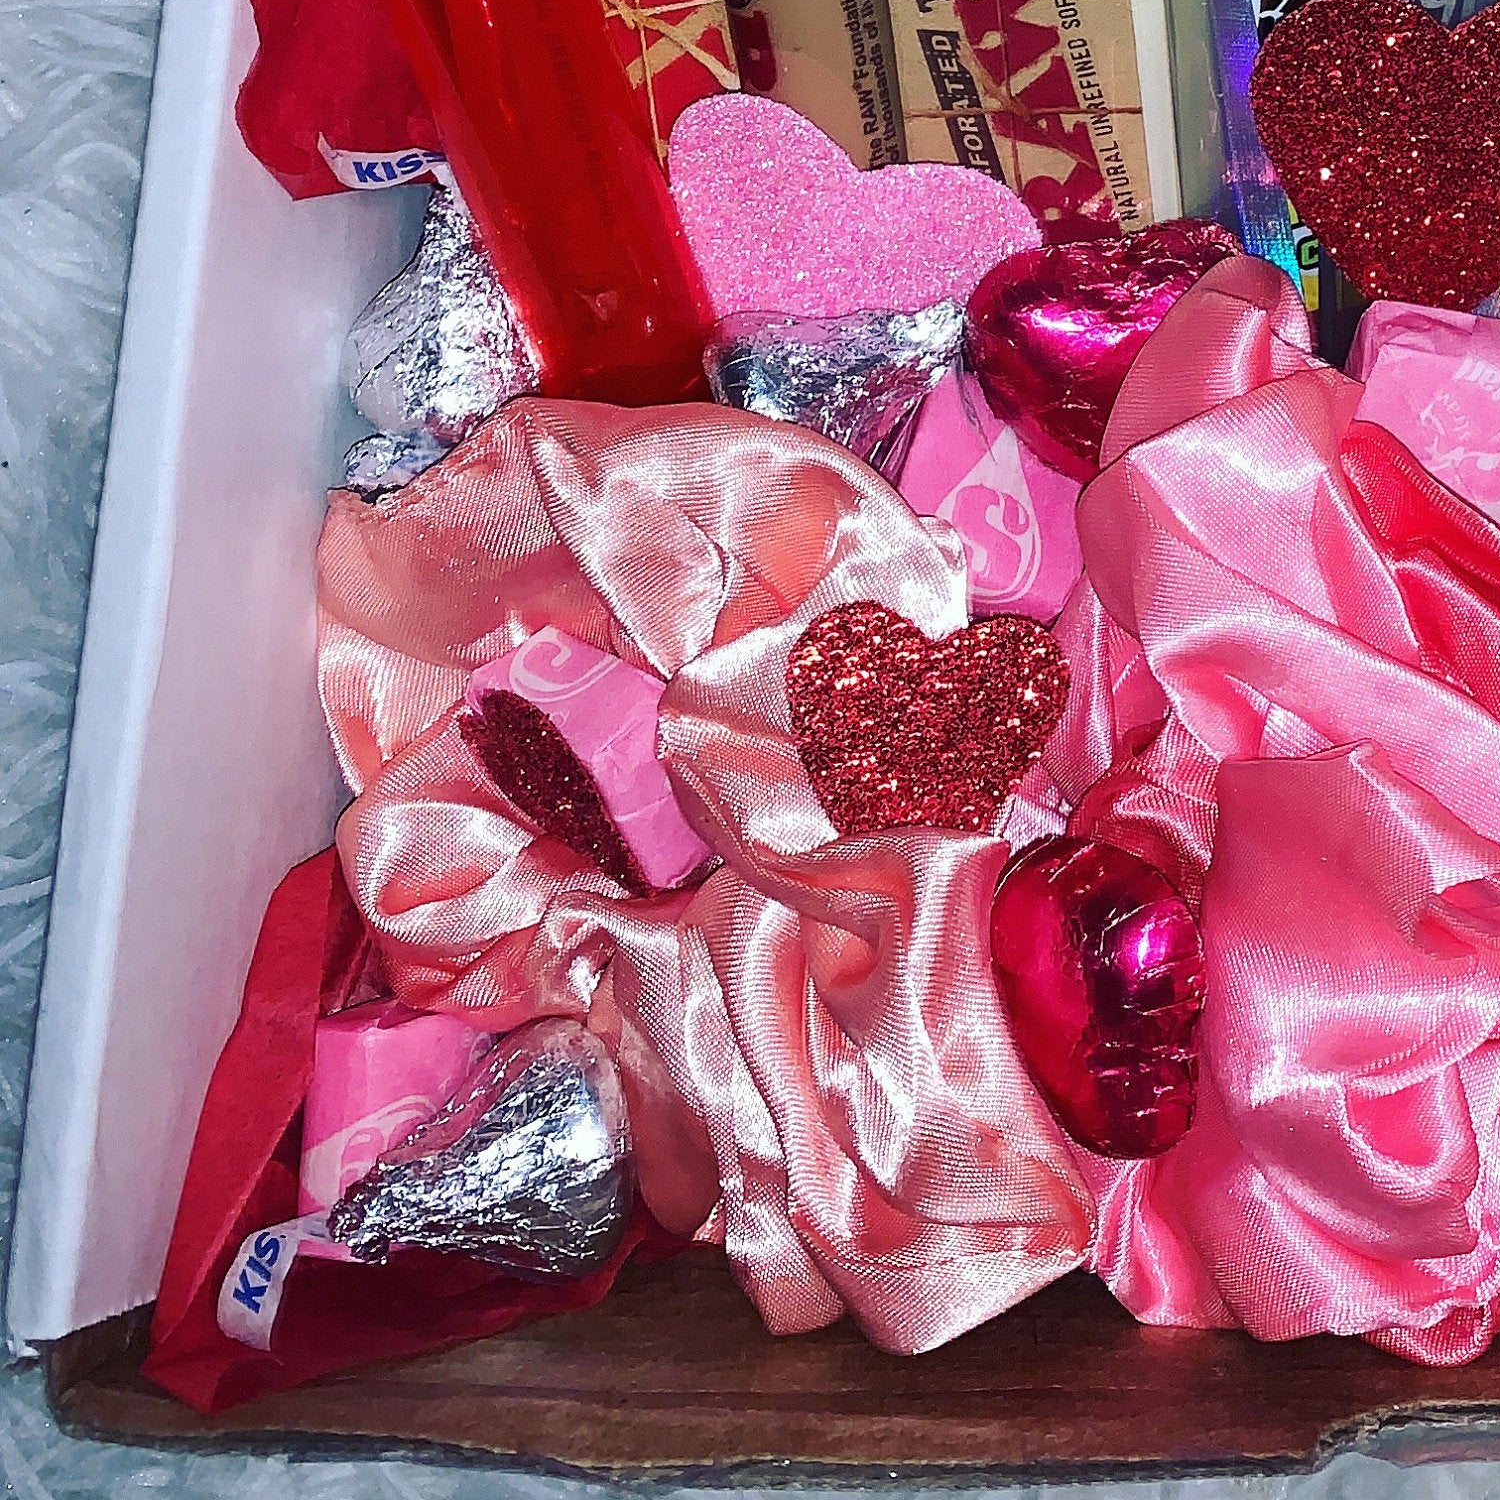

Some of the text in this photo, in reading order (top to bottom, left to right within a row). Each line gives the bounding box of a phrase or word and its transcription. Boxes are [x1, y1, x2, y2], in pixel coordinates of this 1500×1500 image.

[869, 42, 897, 141] thousands
[930, 32, 997, 173] FORATED
[1070, 36, 1114, 138] UNREFINED
[1098, 140, 1139, 222] NATURAL
[232, 1231, 286, 1315] KIS
